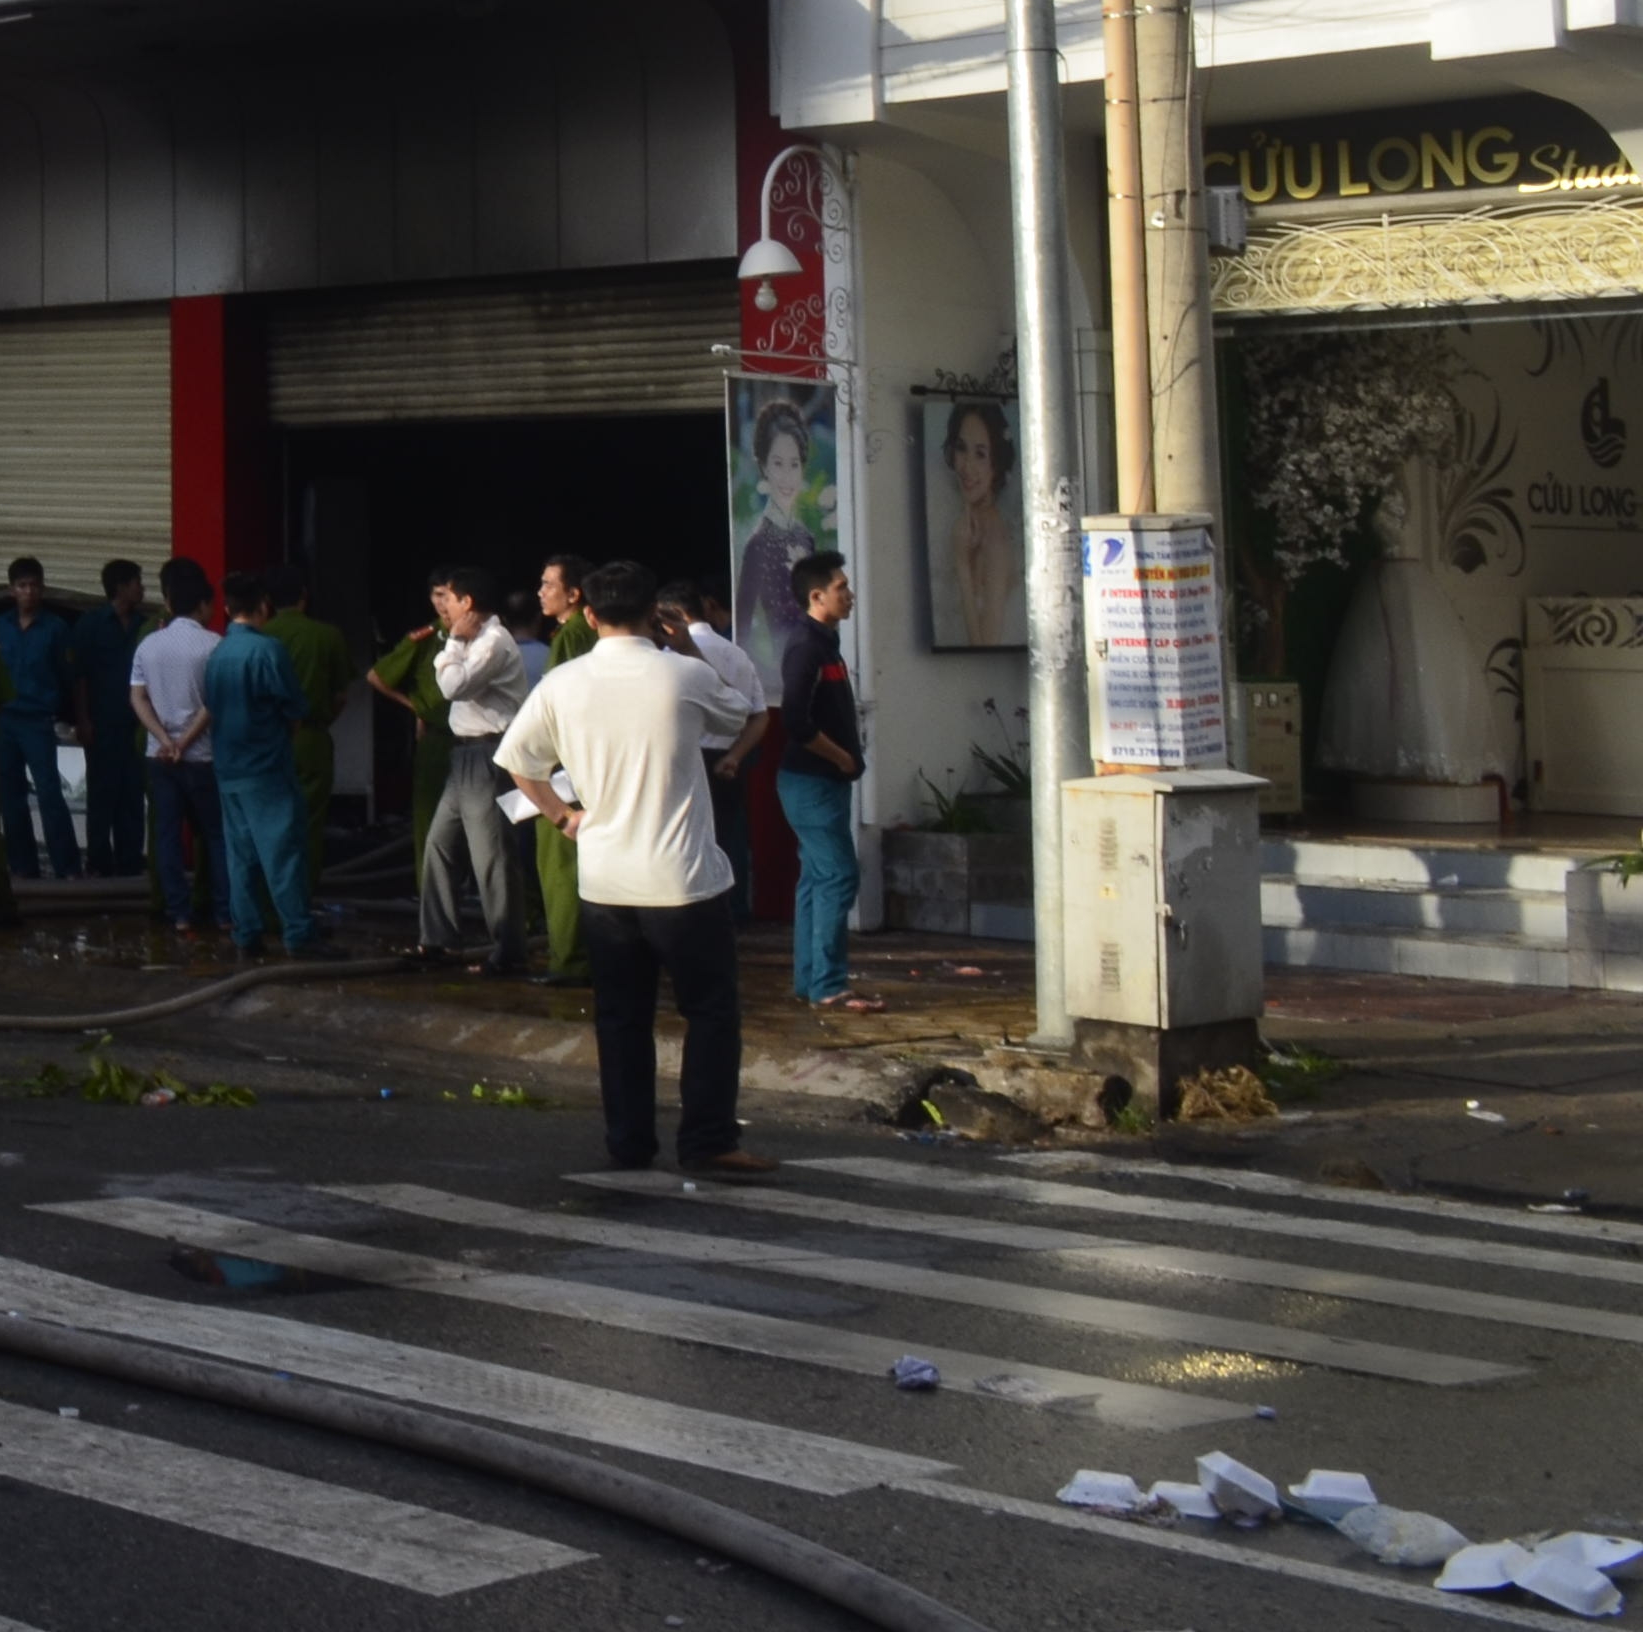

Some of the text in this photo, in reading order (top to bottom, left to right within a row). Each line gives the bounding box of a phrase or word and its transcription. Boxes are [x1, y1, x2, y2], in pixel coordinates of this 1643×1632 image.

[1337, 125, 1520, 198] LONG
[1527, 470, 1637, 518] CỬU LONG
[1109, 588, 1149, 602] INTERNET
